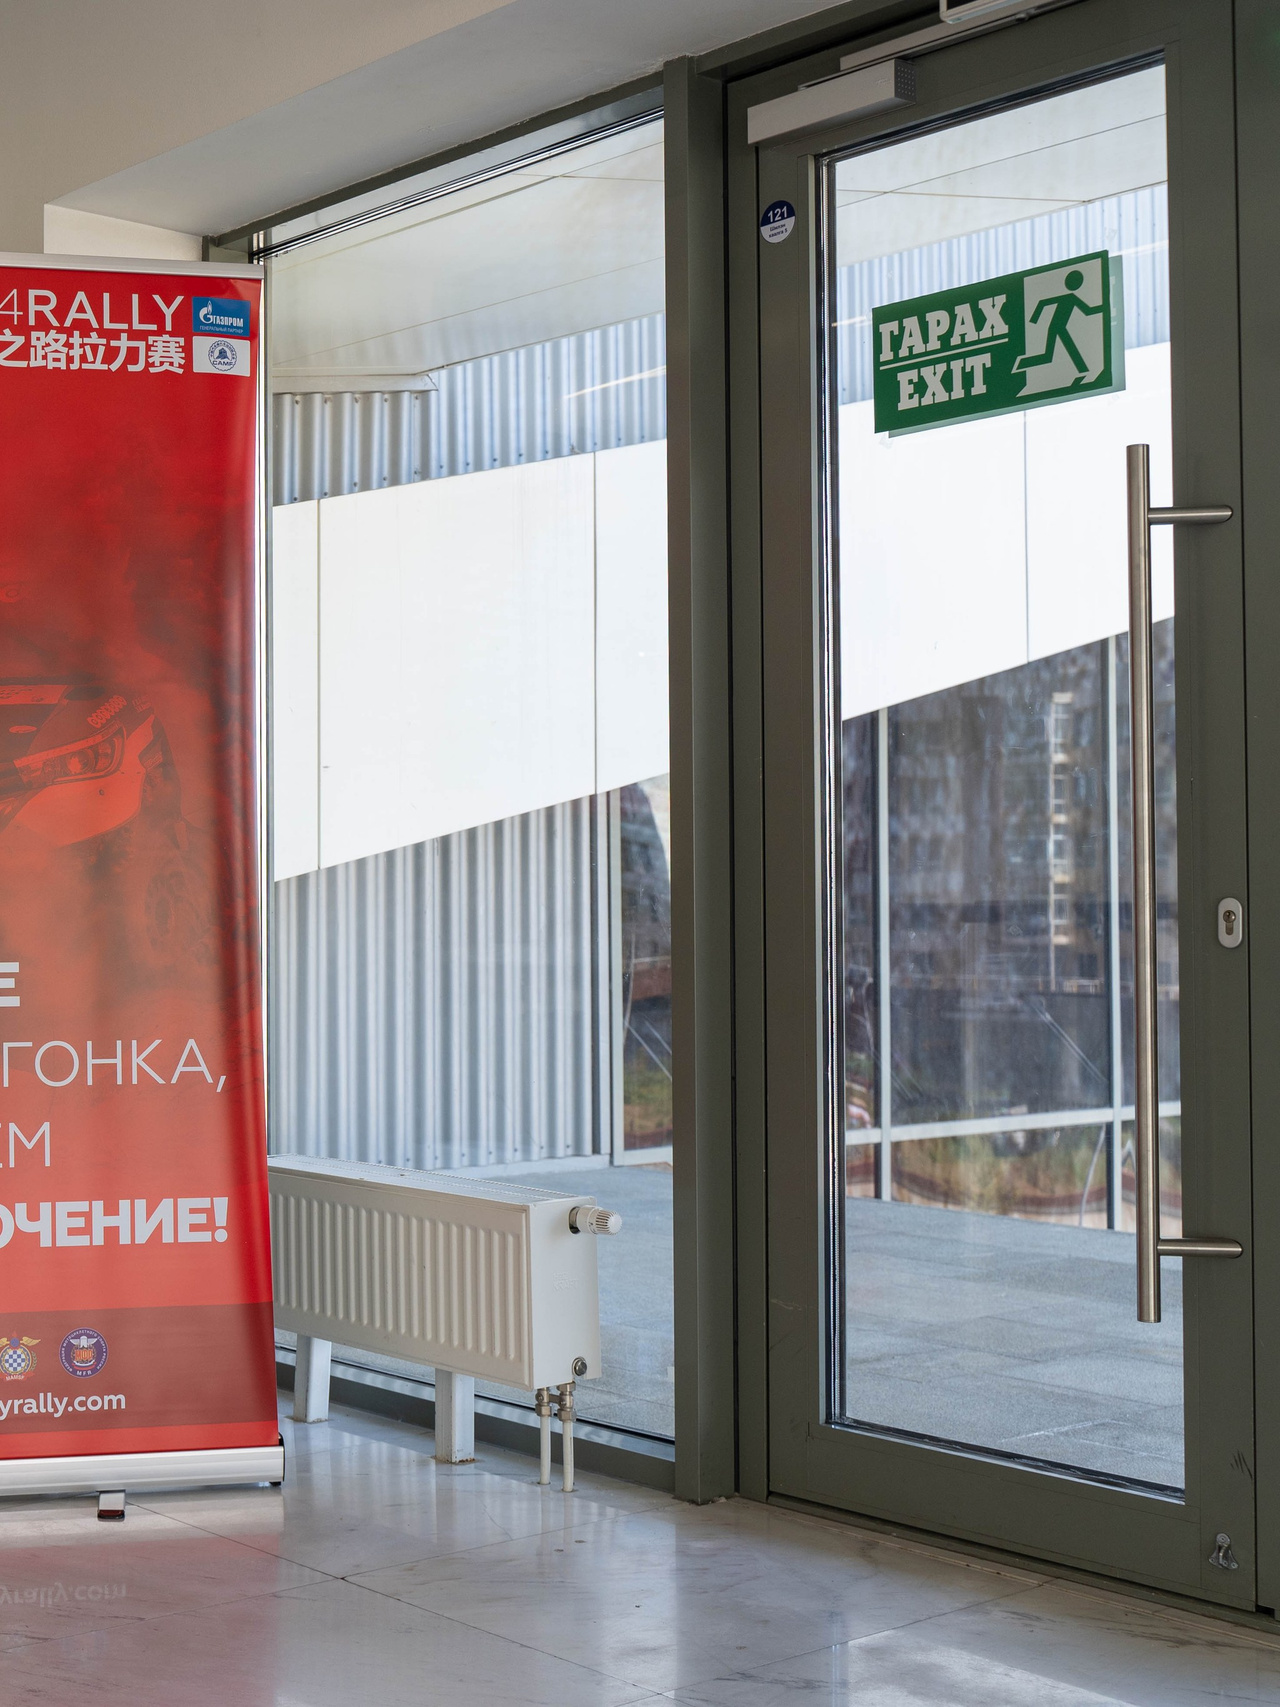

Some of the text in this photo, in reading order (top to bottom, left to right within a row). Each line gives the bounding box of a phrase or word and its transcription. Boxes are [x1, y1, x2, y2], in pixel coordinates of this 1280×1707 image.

[768, 205, 788, 223] 121
[29, 288, 185, 331] RALLY
[879, 294, 1009, 362] ГАРАХ
[897, 352, 992, 411] EXIT
[2, 1039, 227, 1093] ГОНКА,
